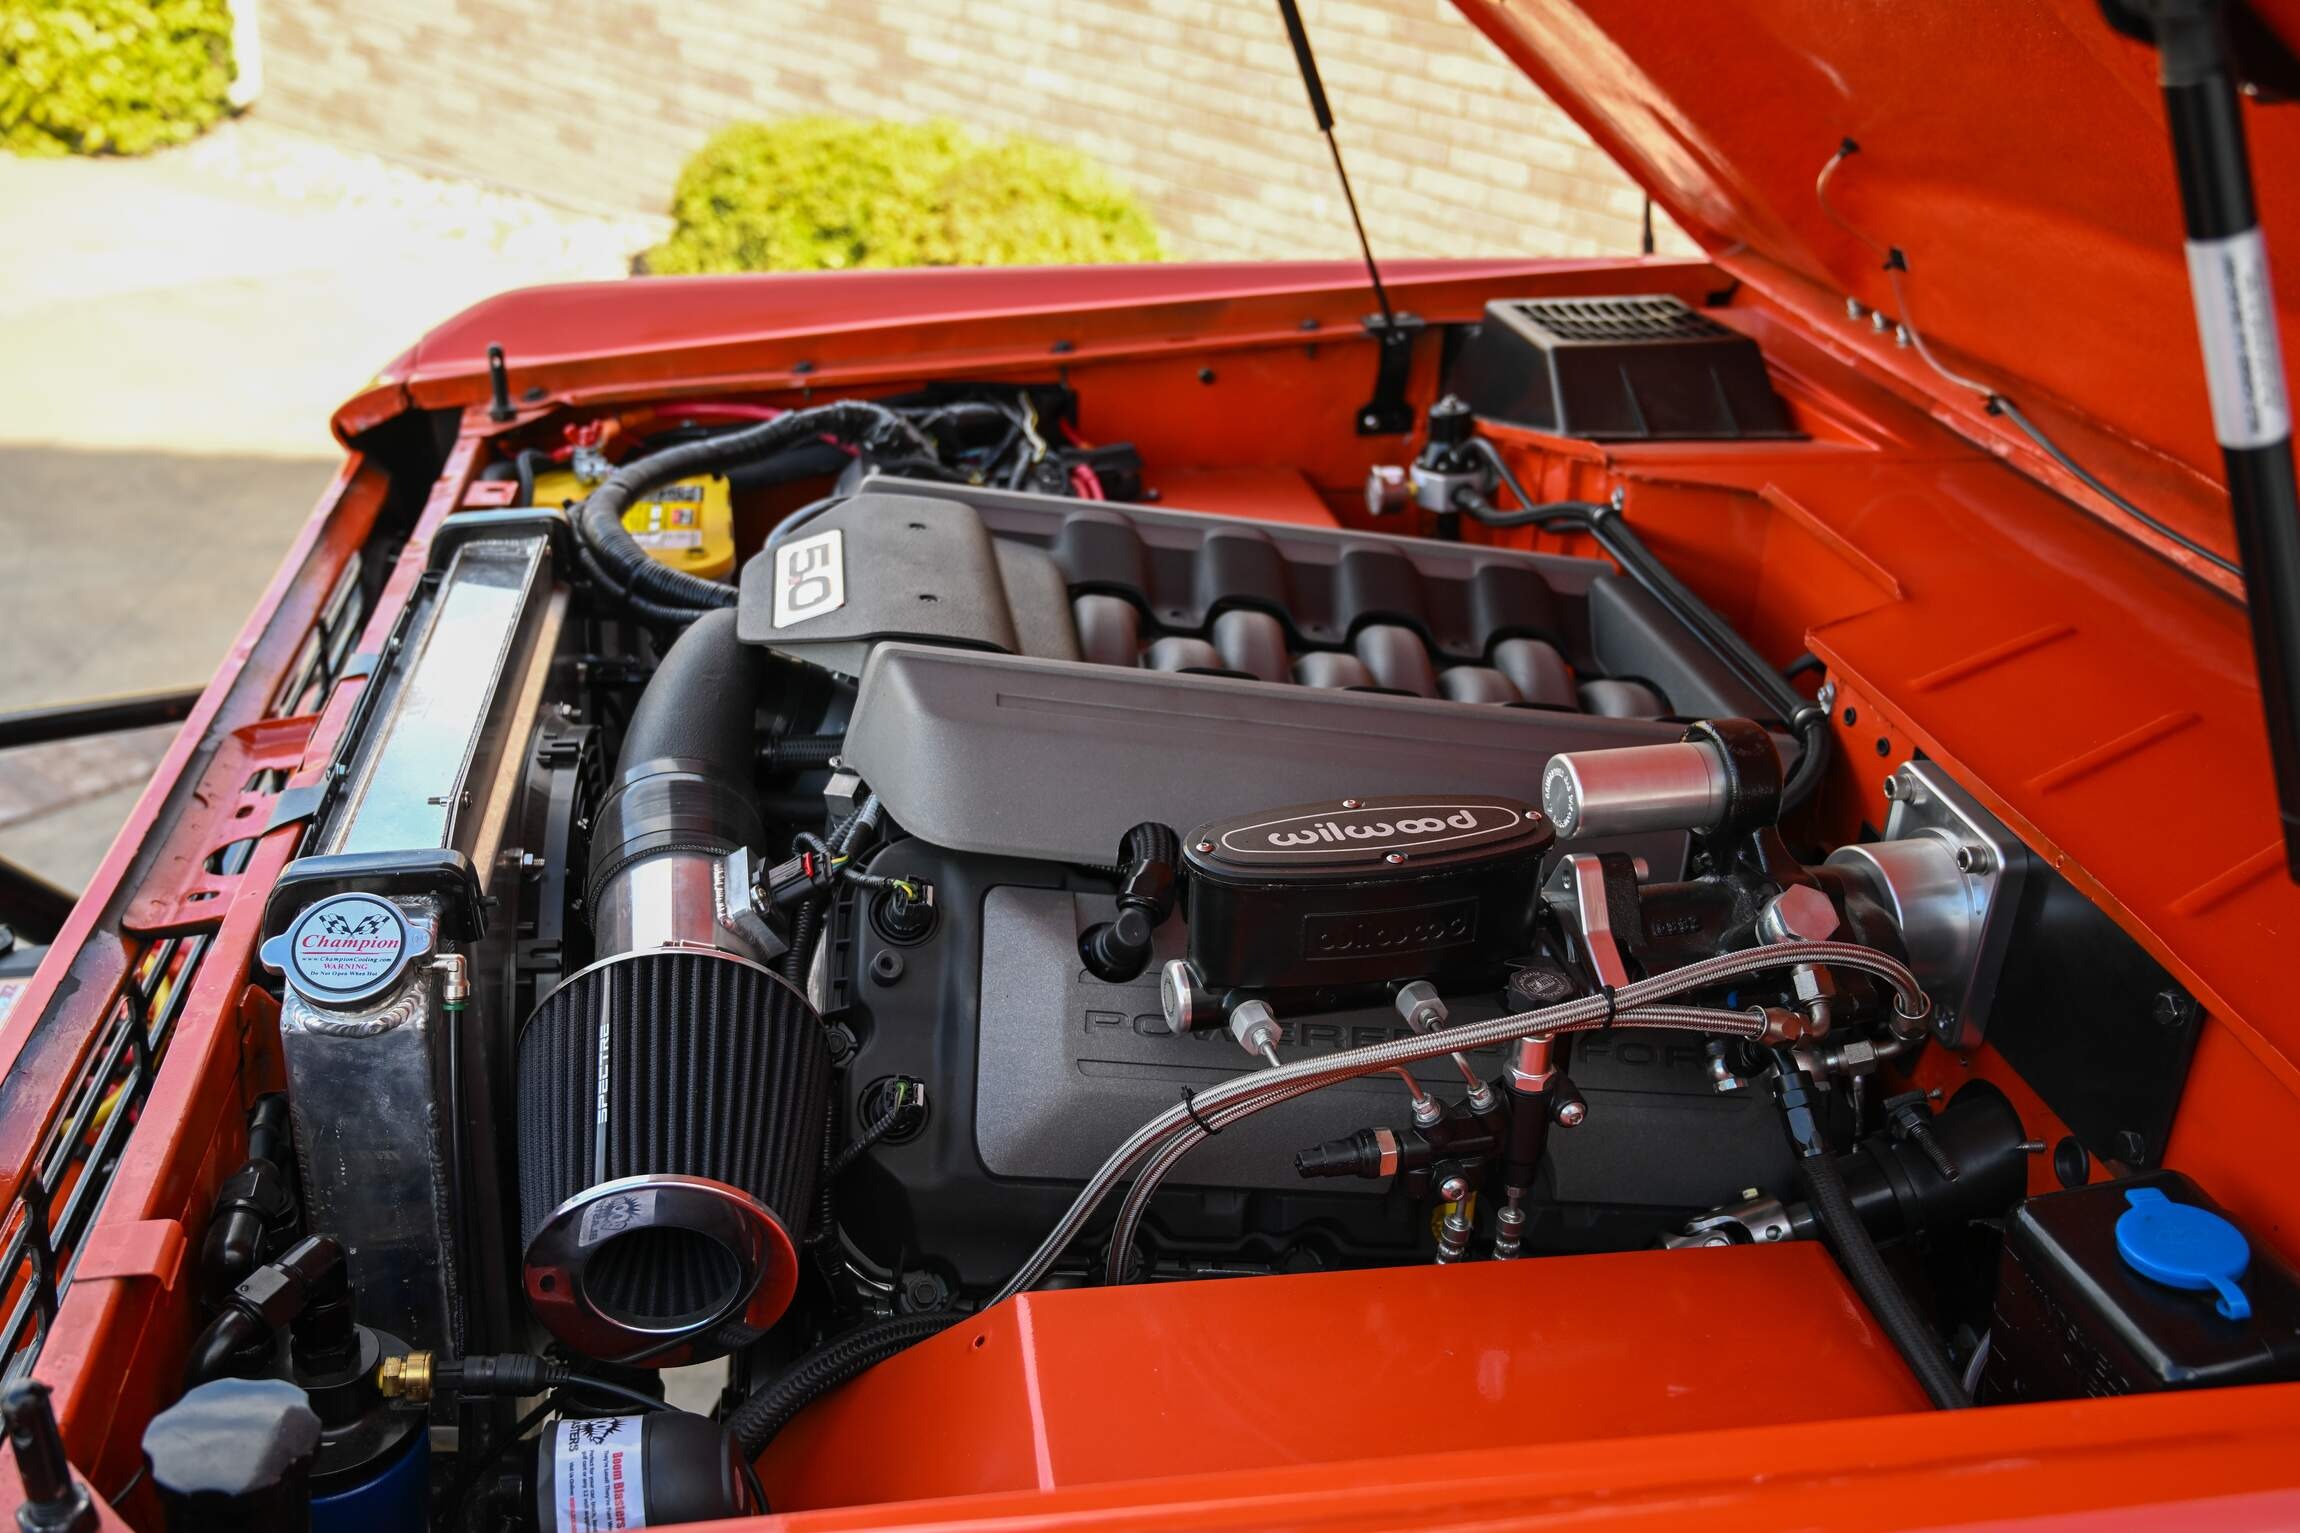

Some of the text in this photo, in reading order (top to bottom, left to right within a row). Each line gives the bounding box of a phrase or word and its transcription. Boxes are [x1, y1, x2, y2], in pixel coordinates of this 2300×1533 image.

[788, 543, 832, 611] 5.0
[1268, 809, 1478, 846] wilwood
[302, 934, 400, 952] Champion
[597, 1023, 610, 1125] SPECTRE
[612, 1452, 626, 1528] Boom Blasters
